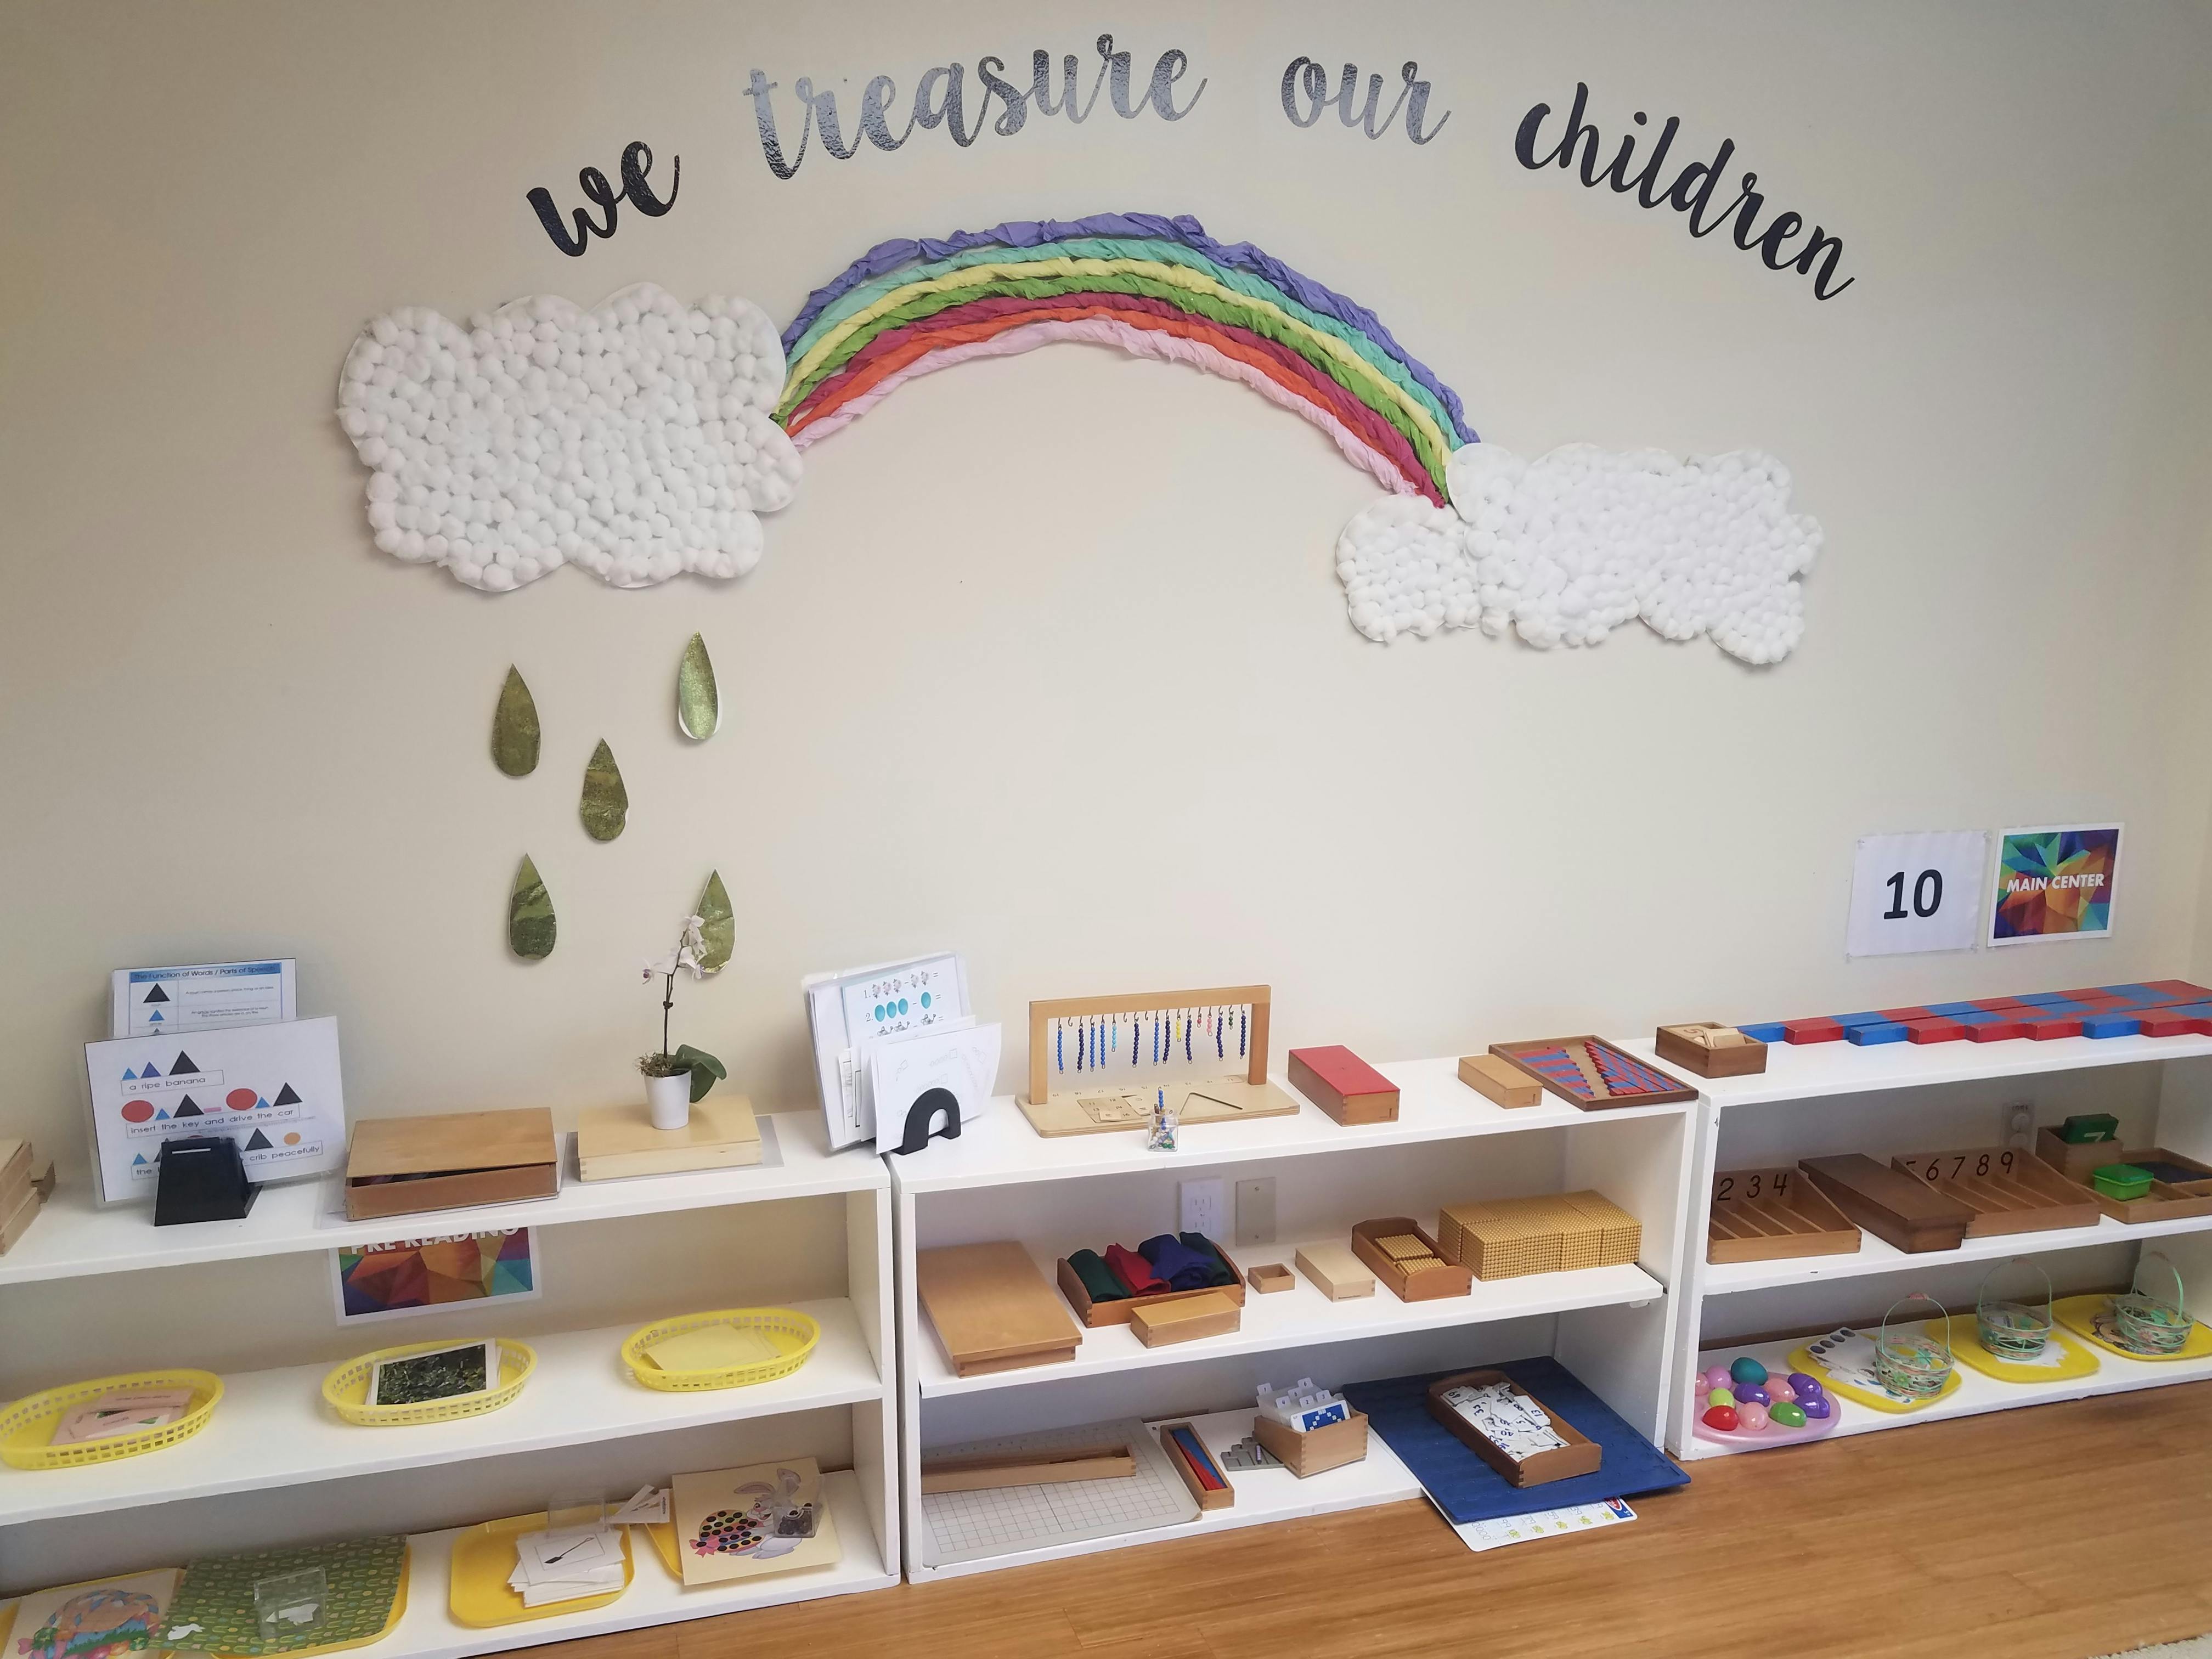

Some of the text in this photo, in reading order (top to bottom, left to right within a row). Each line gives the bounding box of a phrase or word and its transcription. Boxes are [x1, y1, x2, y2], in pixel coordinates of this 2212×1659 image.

[526, 33, 1855, 301] we treasure our children
[1883, 869, 1943, 920] 10
[2006, 873, 2104, 893] MAIN CENTER
[166, 1077, 206, 1087] banana
[131, 1126, 155, 1134] insert
[272, 1146, 319, 1159] peacefully
[1926, 1158, 1940, 1181] 6
[1951, 1156, 1966, 1179] 7
[1976, 1154, 1990, 1176] 8
[2001, 1151, 2013, 1173] 9
[1717, 1174, 1787, 1201] 2 3 4
